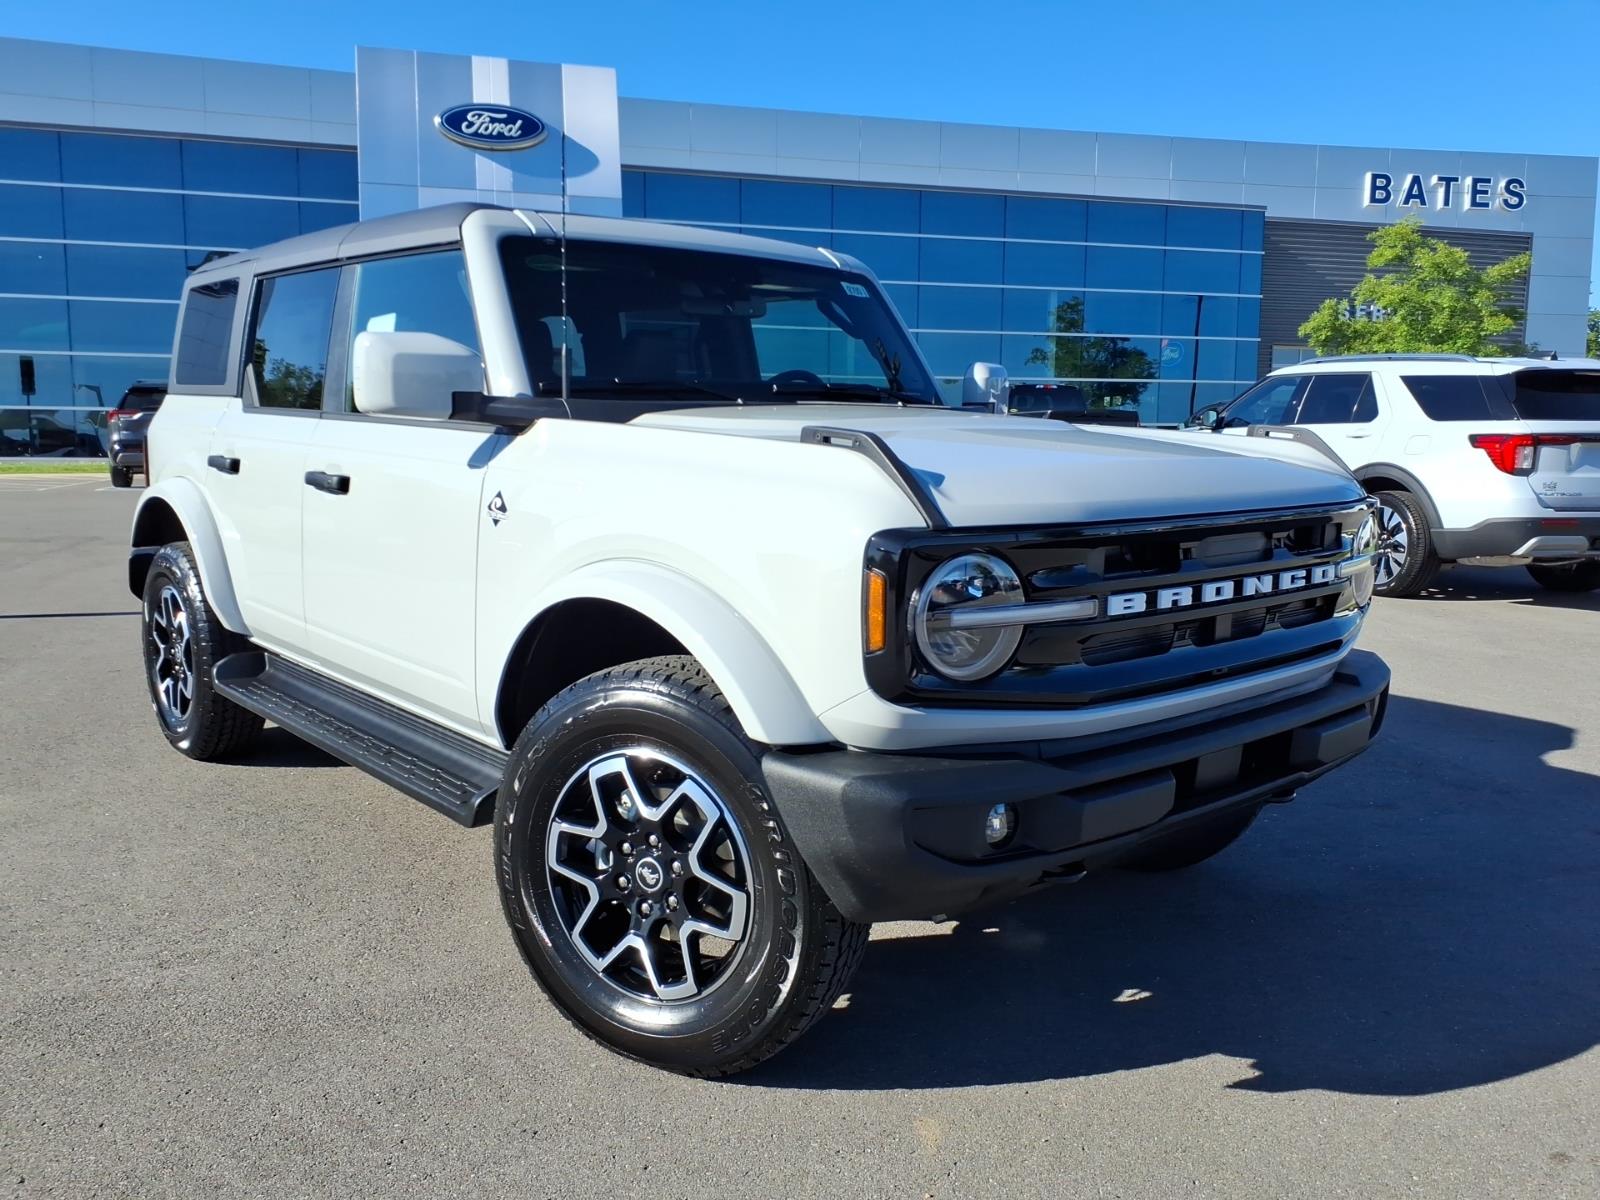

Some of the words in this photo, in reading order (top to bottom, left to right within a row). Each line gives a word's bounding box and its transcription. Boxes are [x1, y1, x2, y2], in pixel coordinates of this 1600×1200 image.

[461, 110, 523, 137] Ford
[1363, 171, 1527, 212] BATES
[1107, 564, 1336, 616] BRONCO
[711, 782, 799, 1054] BRIDGESTONE
